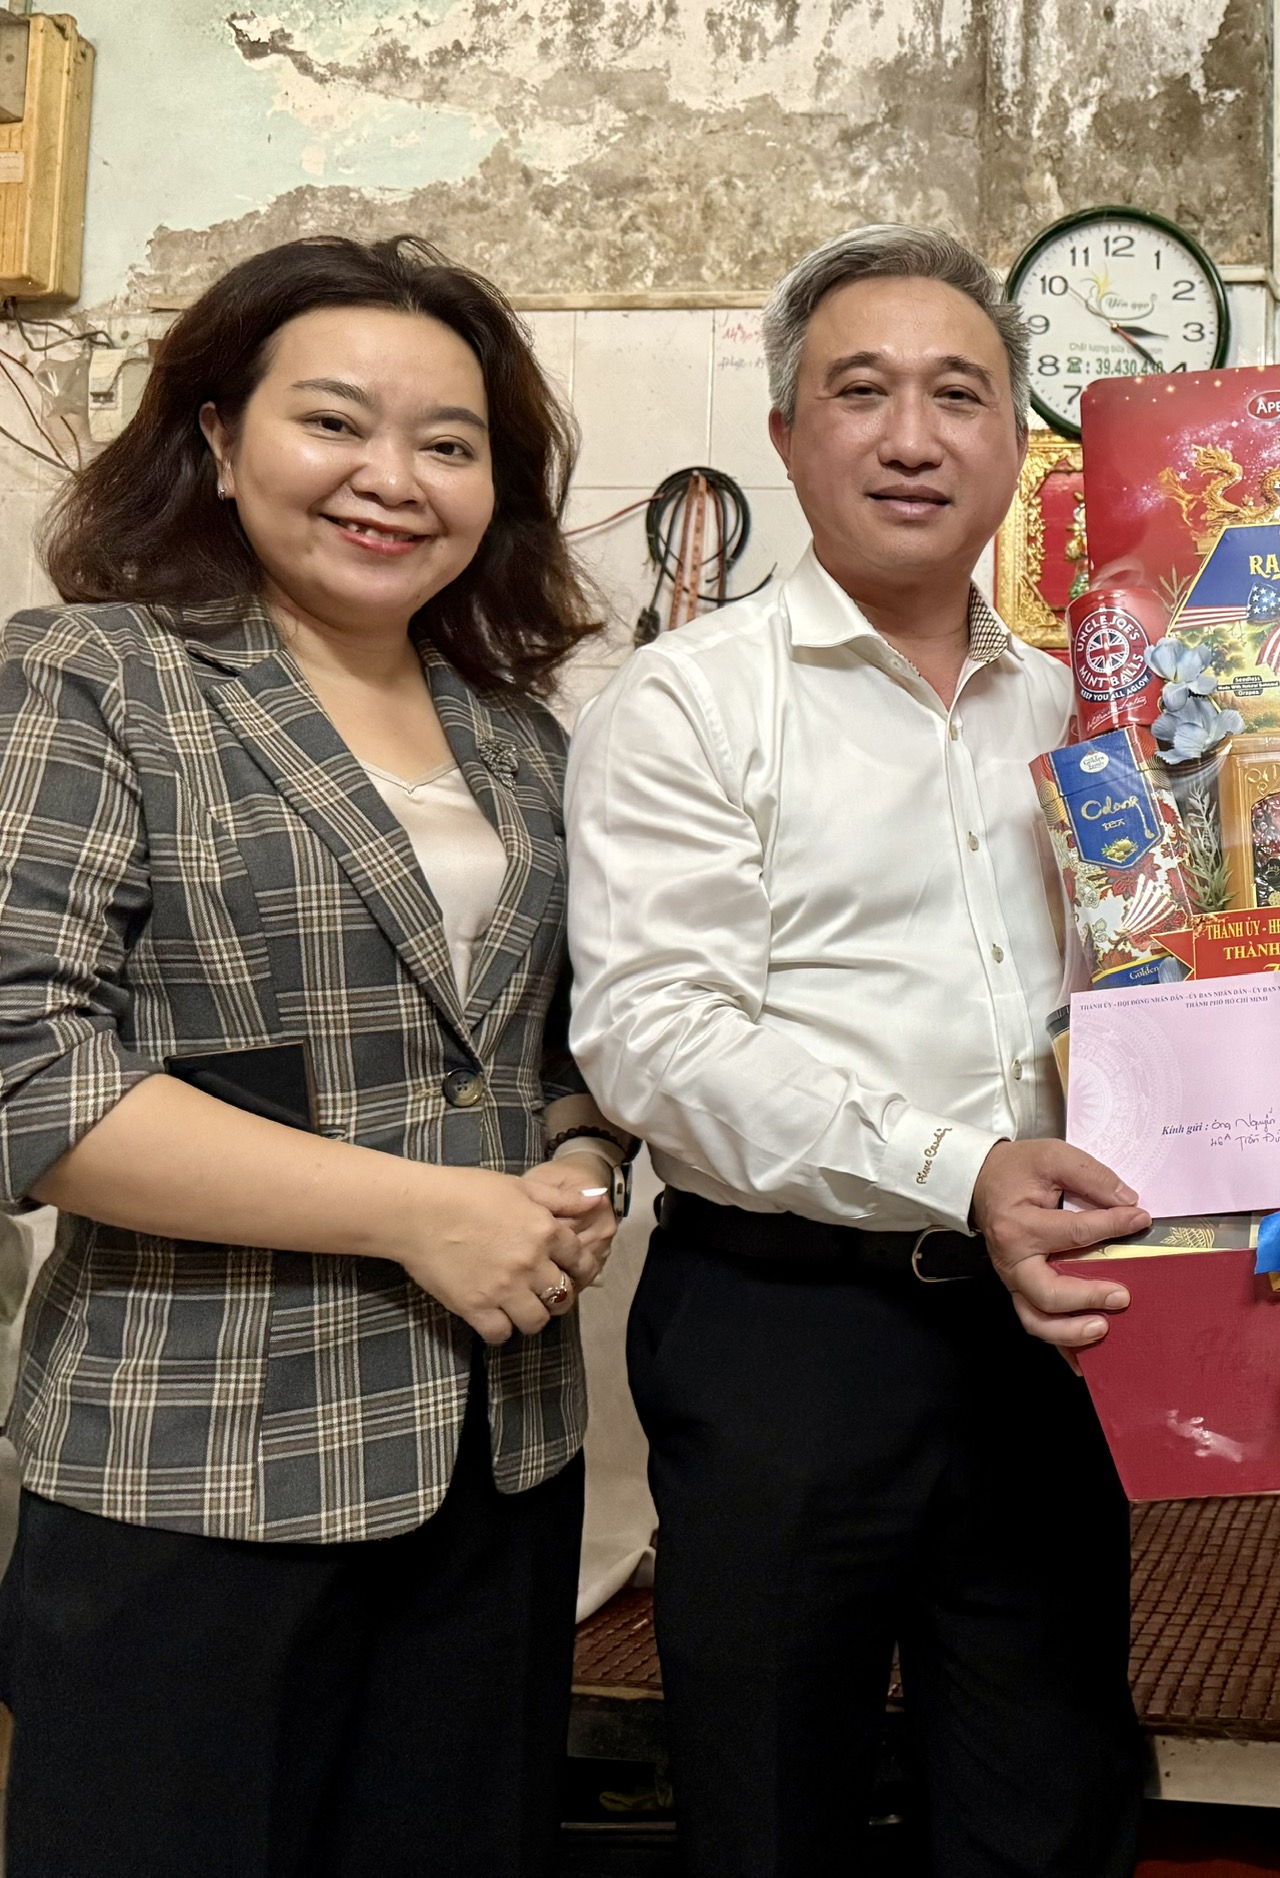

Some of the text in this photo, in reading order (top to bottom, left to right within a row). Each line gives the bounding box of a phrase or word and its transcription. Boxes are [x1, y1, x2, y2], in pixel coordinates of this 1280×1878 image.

[1070, 246, 1090, 267] 11
[1104, 235, 1135, 257] 12
[1154, 250, 1161, 271] 1
[1040, 275, 1069, 296] 10
[1172, 280, 1196, 301] 2
[1028, 315, 1050, 335] 9
[1183, 322, 1205, 342] 3
[1038, 356, 1060, 376] 8
[1064, 385, 1082, 405] 7
[1077, 615, 1140, 652] UNCLE JOE'S
[1079, 653, 1144, 688] MINT BALLS
[1081, 689, 1093, 700] KEEP
[1126, 675, 1149, 696] AGLOW
[1223, 940, 1280, 961] THÀNH
[1130, 965, 1159, 979] Golden
[1250, 995, 1268, 1003] MINH
[1162, 1125, 1184, 1135] Kính
[1186, 1122, 1203, 1134] gửi
[916, 1128, 952, 1185] Pierre Cardin
